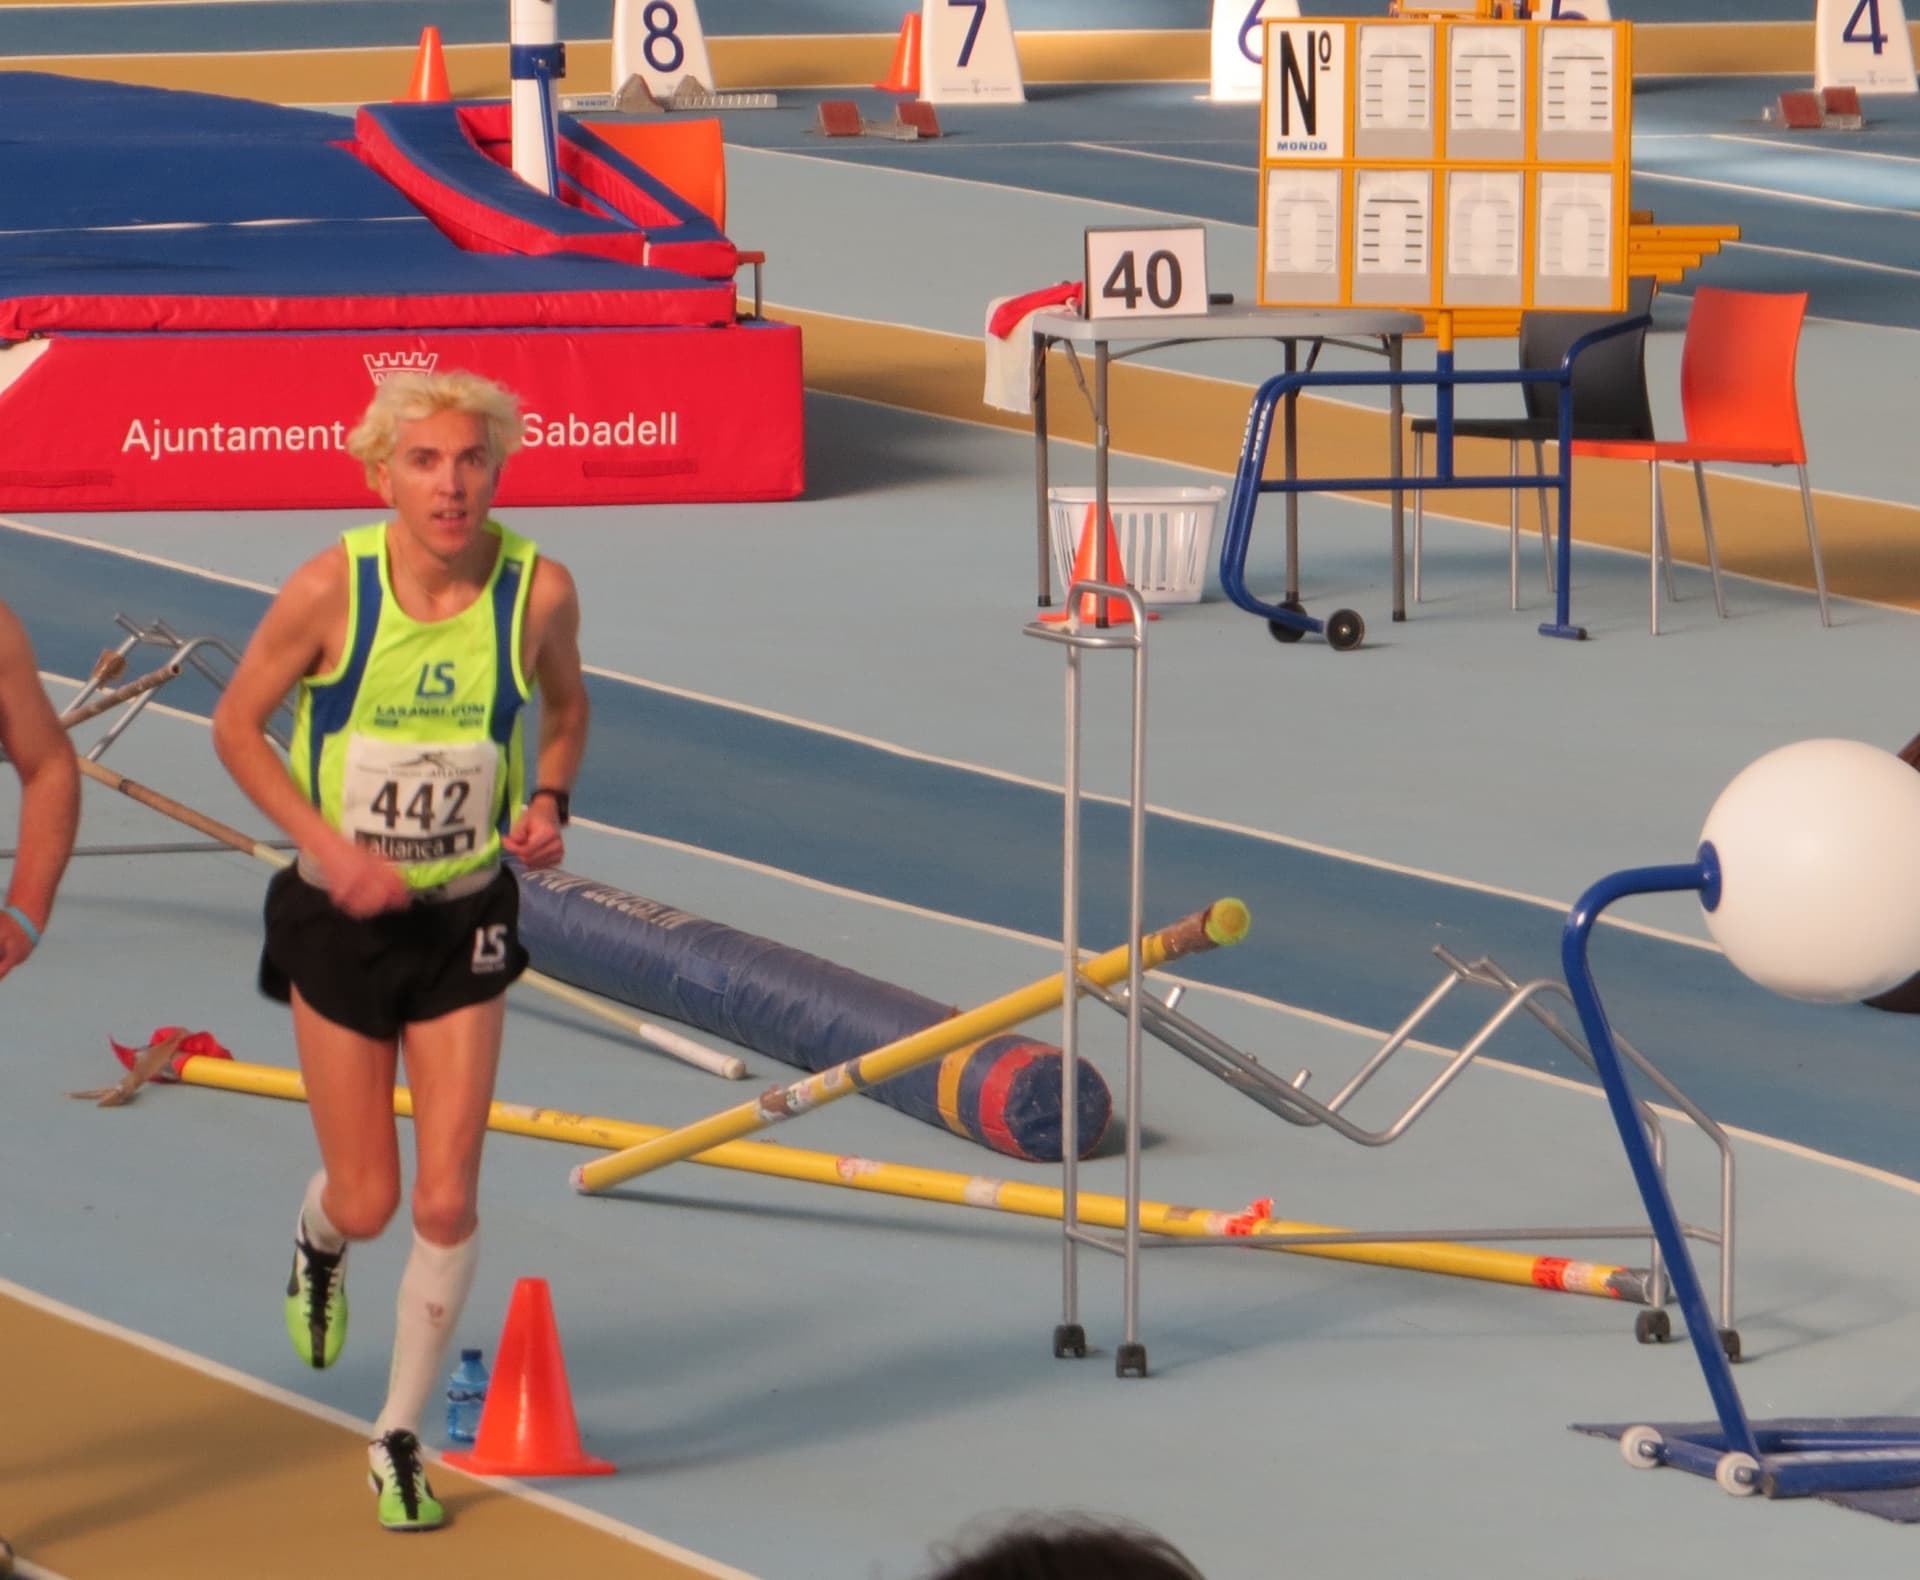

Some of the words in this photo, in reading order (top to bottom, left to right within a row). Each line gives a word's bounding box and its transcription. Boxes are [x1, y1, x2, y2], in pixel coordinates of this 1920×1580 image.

[643, 0, 684, 73] 8
[947, 0, 986, 67] 7
[1842, 0, 1888, 55] 4
[1277, 141, 1328, 151] MONDO
[1102, 249, 1182, 309] 40
[121, 417, 345, 461] Ajuntament
[520, 412, 677, 447] Sabadell
[370, 780, 470, 830] 442
